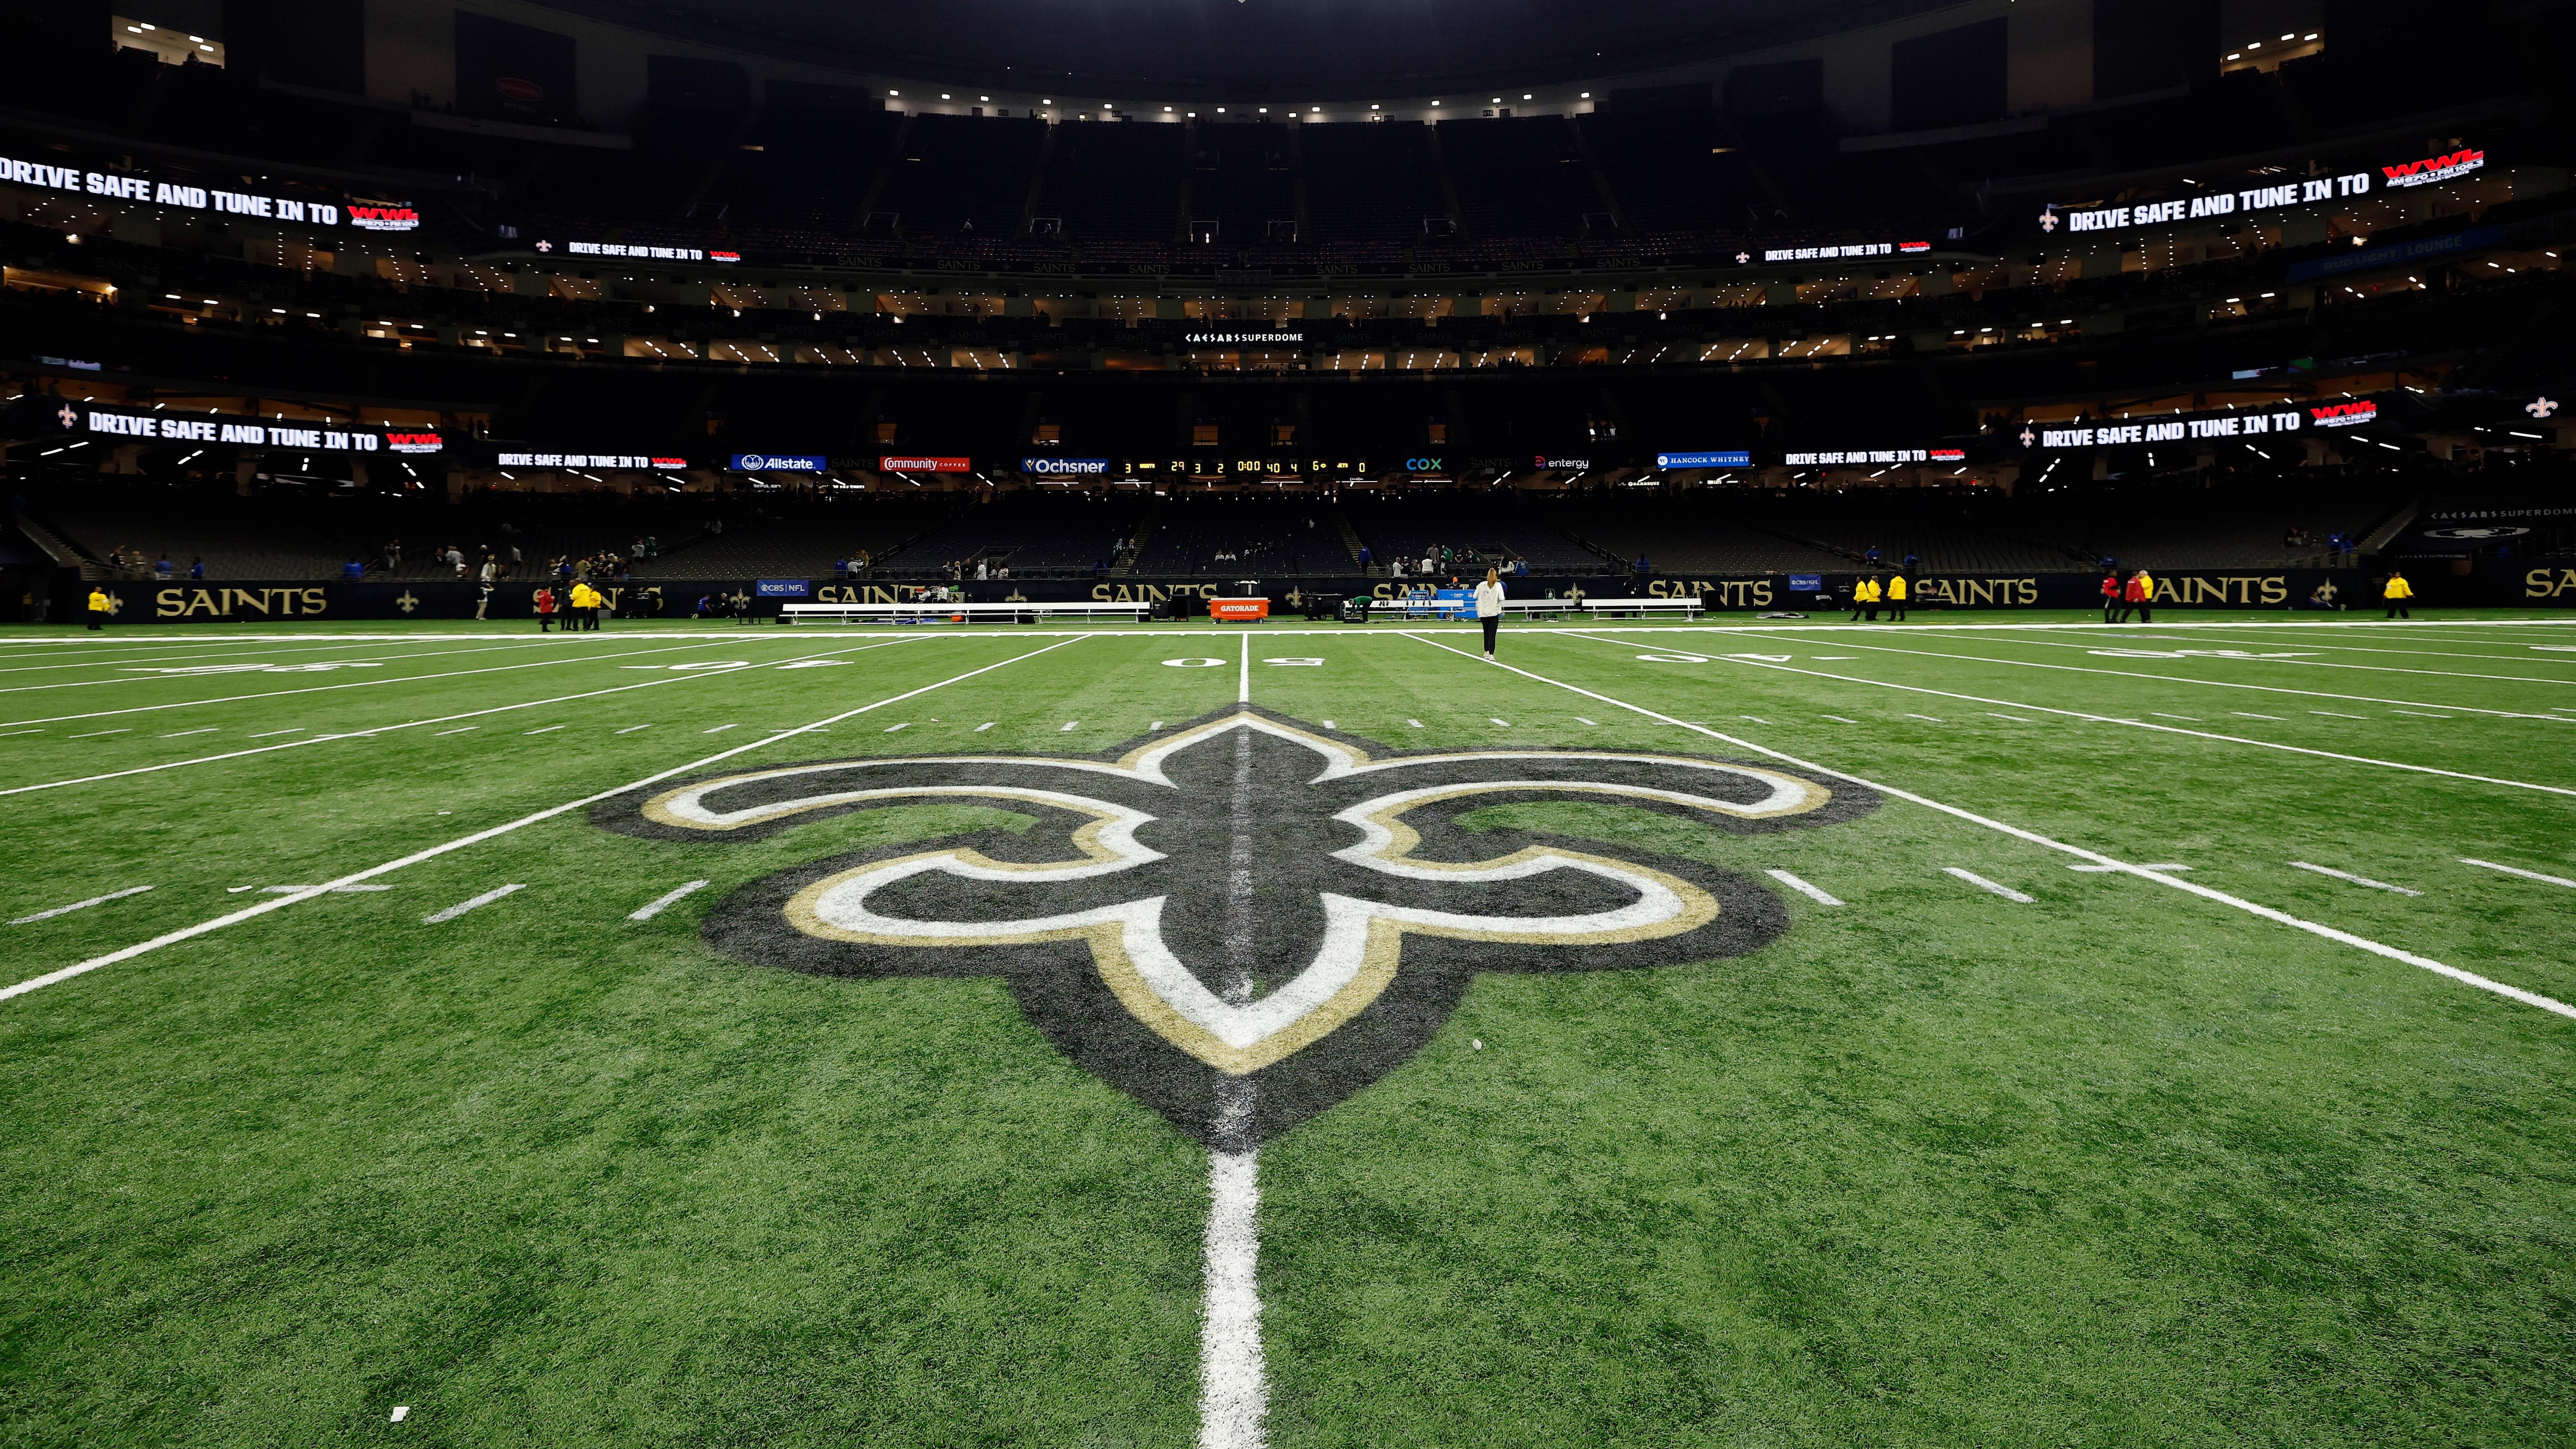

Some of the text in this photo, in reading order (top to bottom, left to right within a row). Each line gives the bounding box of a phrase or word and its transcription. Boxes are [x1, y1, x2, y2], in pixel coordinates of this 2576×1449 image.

[0, 157, 336, 225] DRIVE SAFE AND TUNE IN TO
[2070, 173, 2369, 231] DRIVE SAFE AND TUNE IN TO
[569, 242, 601, 254] DRIVE
[602, 244, 626, 255] SAFE
[628, 246, 648, 257] AND
[650, 247, 674, 258] TUNE
[676, 248, 688, 259] IN
[690, 249, 703, 260] TO
[2407, 235, 2463, 257] LOUNGE
[1766, 249, 1793, 261] DRIVE
[1795, 248, 1818, 259] SAFE
[1820, 247, 1838, 258] AND
[1840, 245, 1864, 256] TUNE
[1866, 244, 1877, 254] IN
[1879, 244, 1891, 253] TO
[838, 257, 882, 267] SAINTS
[938, 259, 980, 270] SAINTS
[1033, 263, 1075, 272] SAINTS
[1409, 262, 1450, 272] SAINTS
[1502, 260, 1544, 271] SAINTS
[1597, 257, 1640, 268] SAINTS
[1129, 264, 1170, 274] SAINTS
[1316, 264, 1358, 274] SAINTS
[1185, 333, 1303, 342] CAESARS SUPERDOME
[90, 412, 377, 450] DRIVE SAFE AND TUNE IN TO
[2044, 413, 2299, 447] DRIVE SAFE AND TUNE IN TO
[499, 454, 532, 465] DRIVE
[535, 454, 562, 466] SAFE
[565, 455, 586, 466] AND
[588, 455, 617, 467] TUNE
[619, 456, 632, 467] IN
[634, 456, 648, 467] TO
[832, 458, 875, 468] SAINTS
[1471, 458, 1511, 468] SAINTS
[1786, 453, 1817, 465] DRIVE
[1819, 452, 1844, 464] SAFE
[1846, 452, 1867, 463] AND
[1869, 451, 1895, 462] TUNE
[1897, 450, 1910, 461] IN
[1912, 450, 1926, 461] TO
[764, 458, 814, 469] Allstate
[884, 457, 937, 471] Community
[1036, 458, 1105, 473] Ochsner
[1125, 464, 1131, 473] 3
[1171, 462, 1184, 471] 29
[1195, 464, 1201, 473] 3
[1217, 464, 1224, 473] 2
[1238, 461, 1261, 471] 0:00
[1267, 463, 1280, 473] 40
[1291, 464, 1298, 472] 4
[1312, 461, 1319, 471] 6
[1359, 463, 1365, 472] 0
[1406, 458, 1442, 470] COX
[1548, 458, 1589, 469] entergy
[818, 584, 926, 604] SAINT
[1914, 577, 2039, 605] SAINTS
[2151, 575, 2289, 604] AINTS
[156, 587, 328, 618] SAINTS
